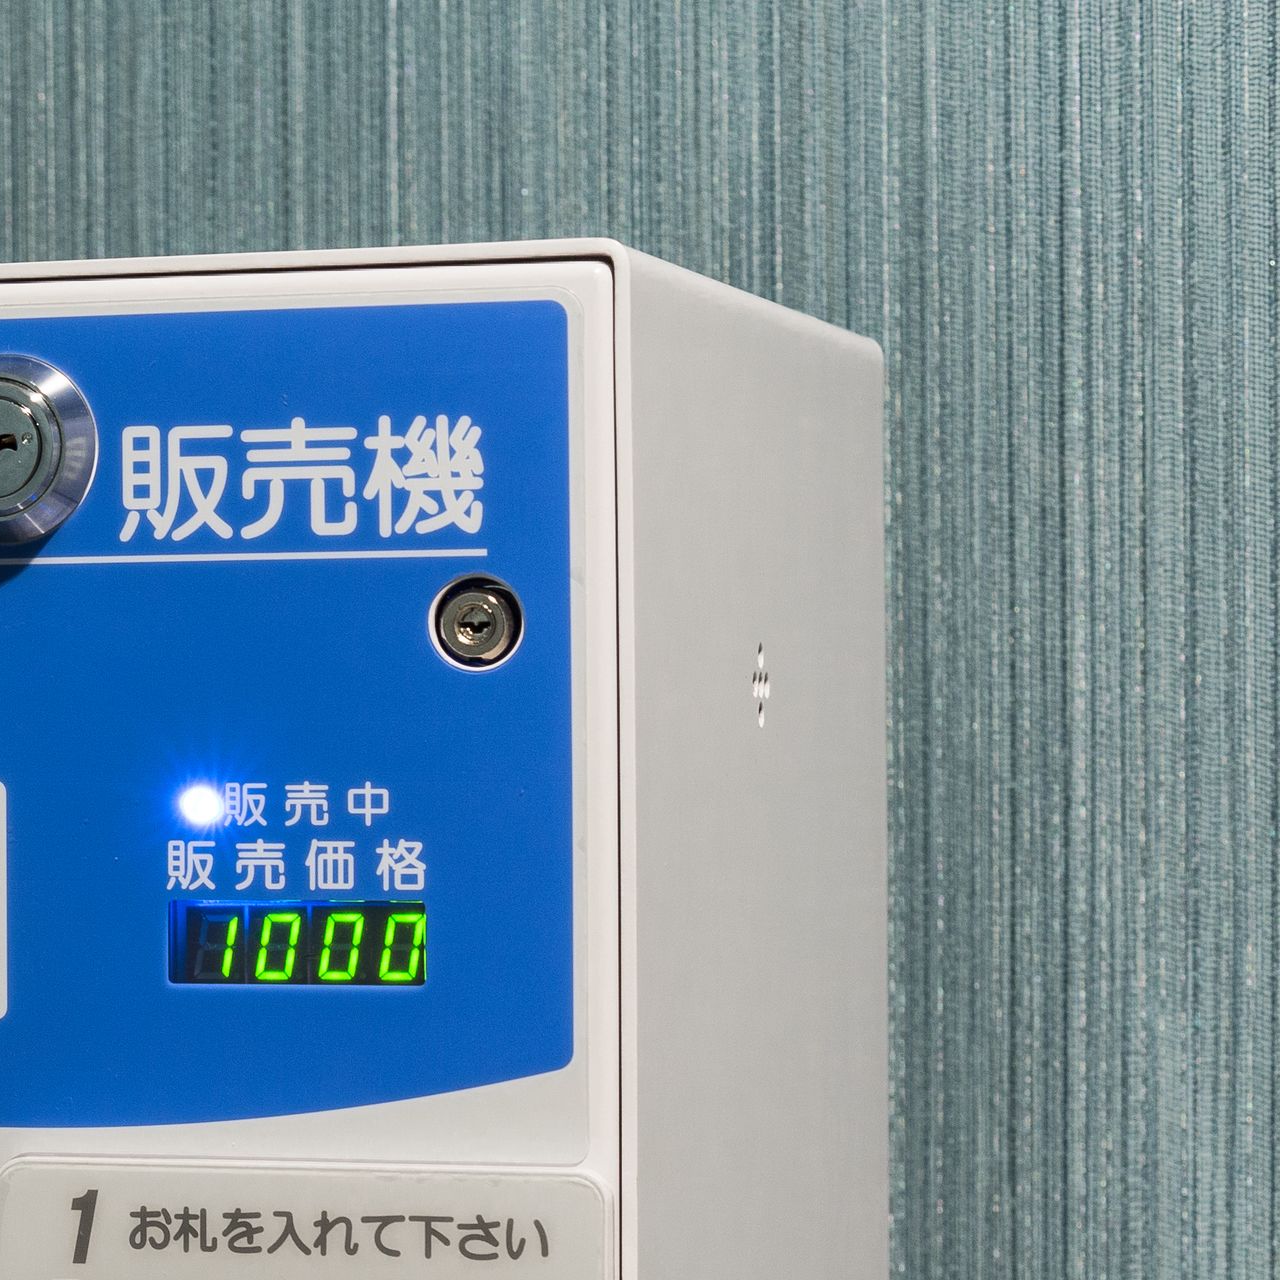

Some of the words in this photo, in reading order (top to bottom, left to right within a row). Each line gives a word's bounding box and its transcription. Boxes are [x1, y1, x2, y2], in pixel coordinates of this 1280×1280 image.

[118, 414, 486, 543] 販売機
[223, 780, 390, 828] 販売中
[166, 838, 427, 892] 販売価格
[221, 912, 425, 981] 1000
[70, 1188, 99, 1265] 1
[127, 1205, 550, 1262] お札を入れて下さい
